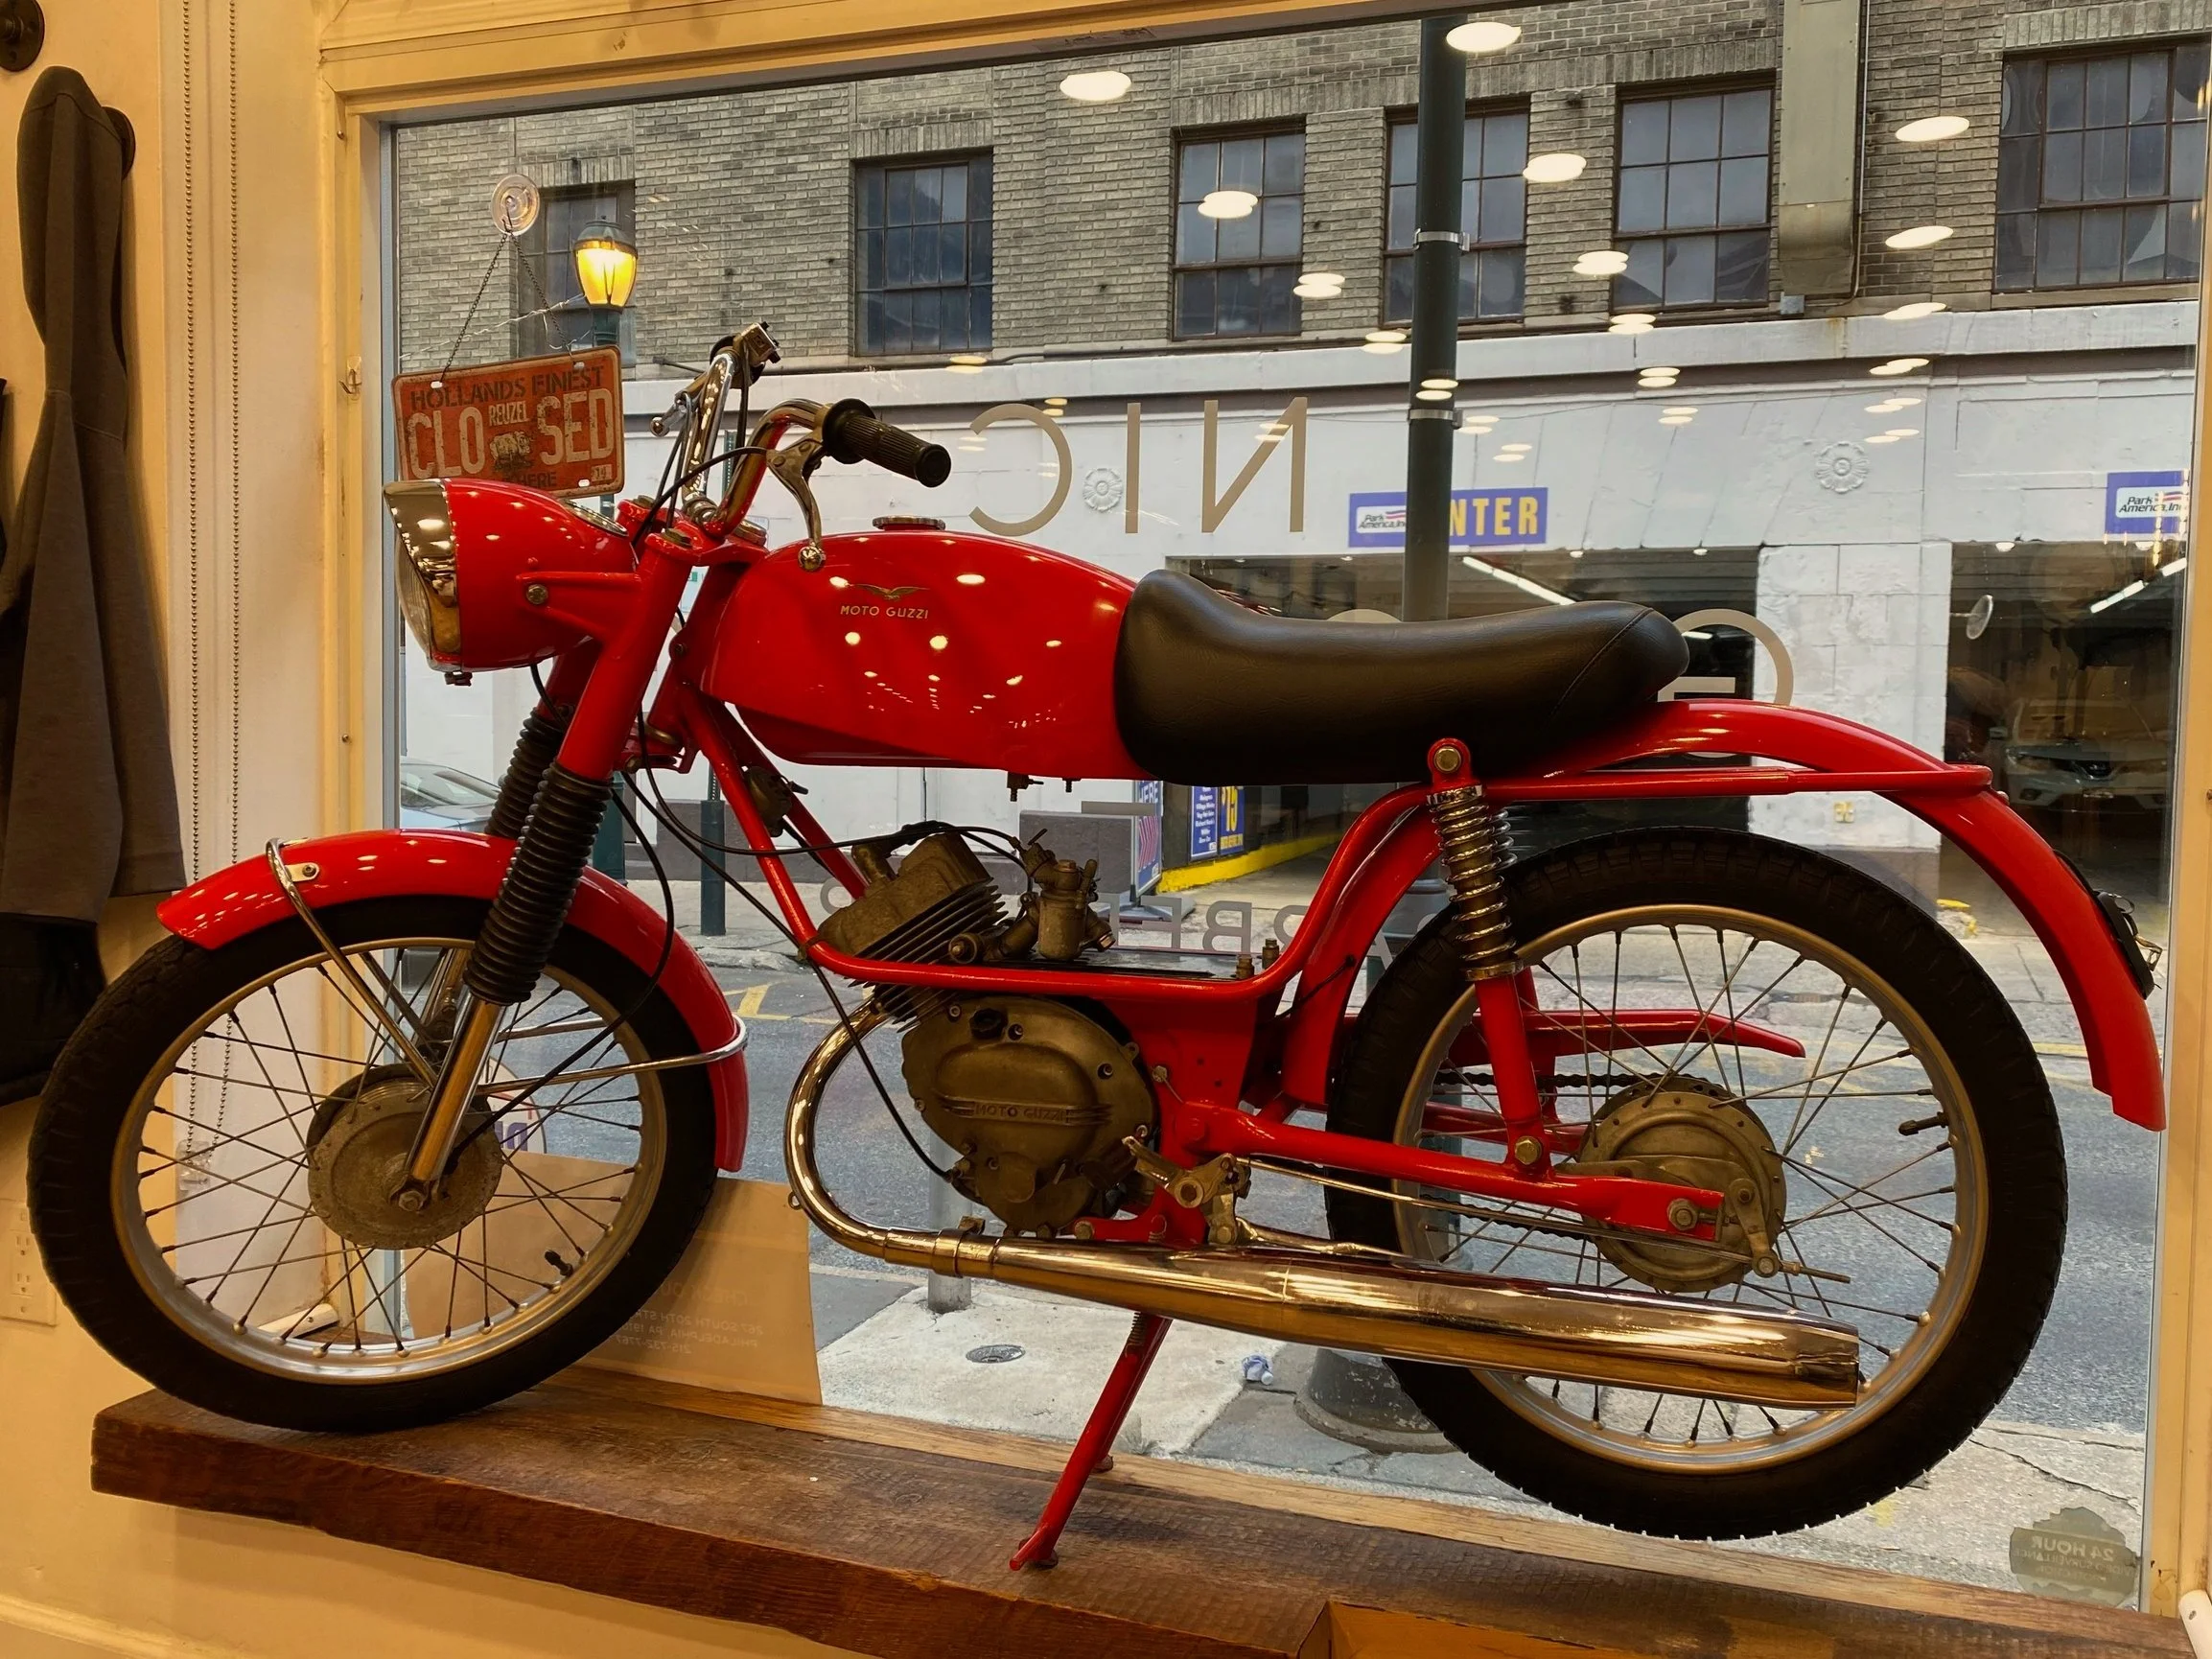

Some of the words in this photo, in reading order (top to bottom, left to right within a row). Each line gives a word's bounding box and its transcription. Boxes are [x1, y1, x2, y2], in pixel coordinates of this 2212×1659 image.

[531, 366, 604, 395] FINEST
[488, 400, 529, 427] REUZEL
[2128, 496, 2153, 505] Park
[1450, 497, 1539, 536] NTER
[840, 605, 880, 617] MOTO
[886, 606, 929, 619] GUZZI
[974, 1104, 1018, 1118] MOTO
[1023, 1107, 1066, 1122] GUZZI
